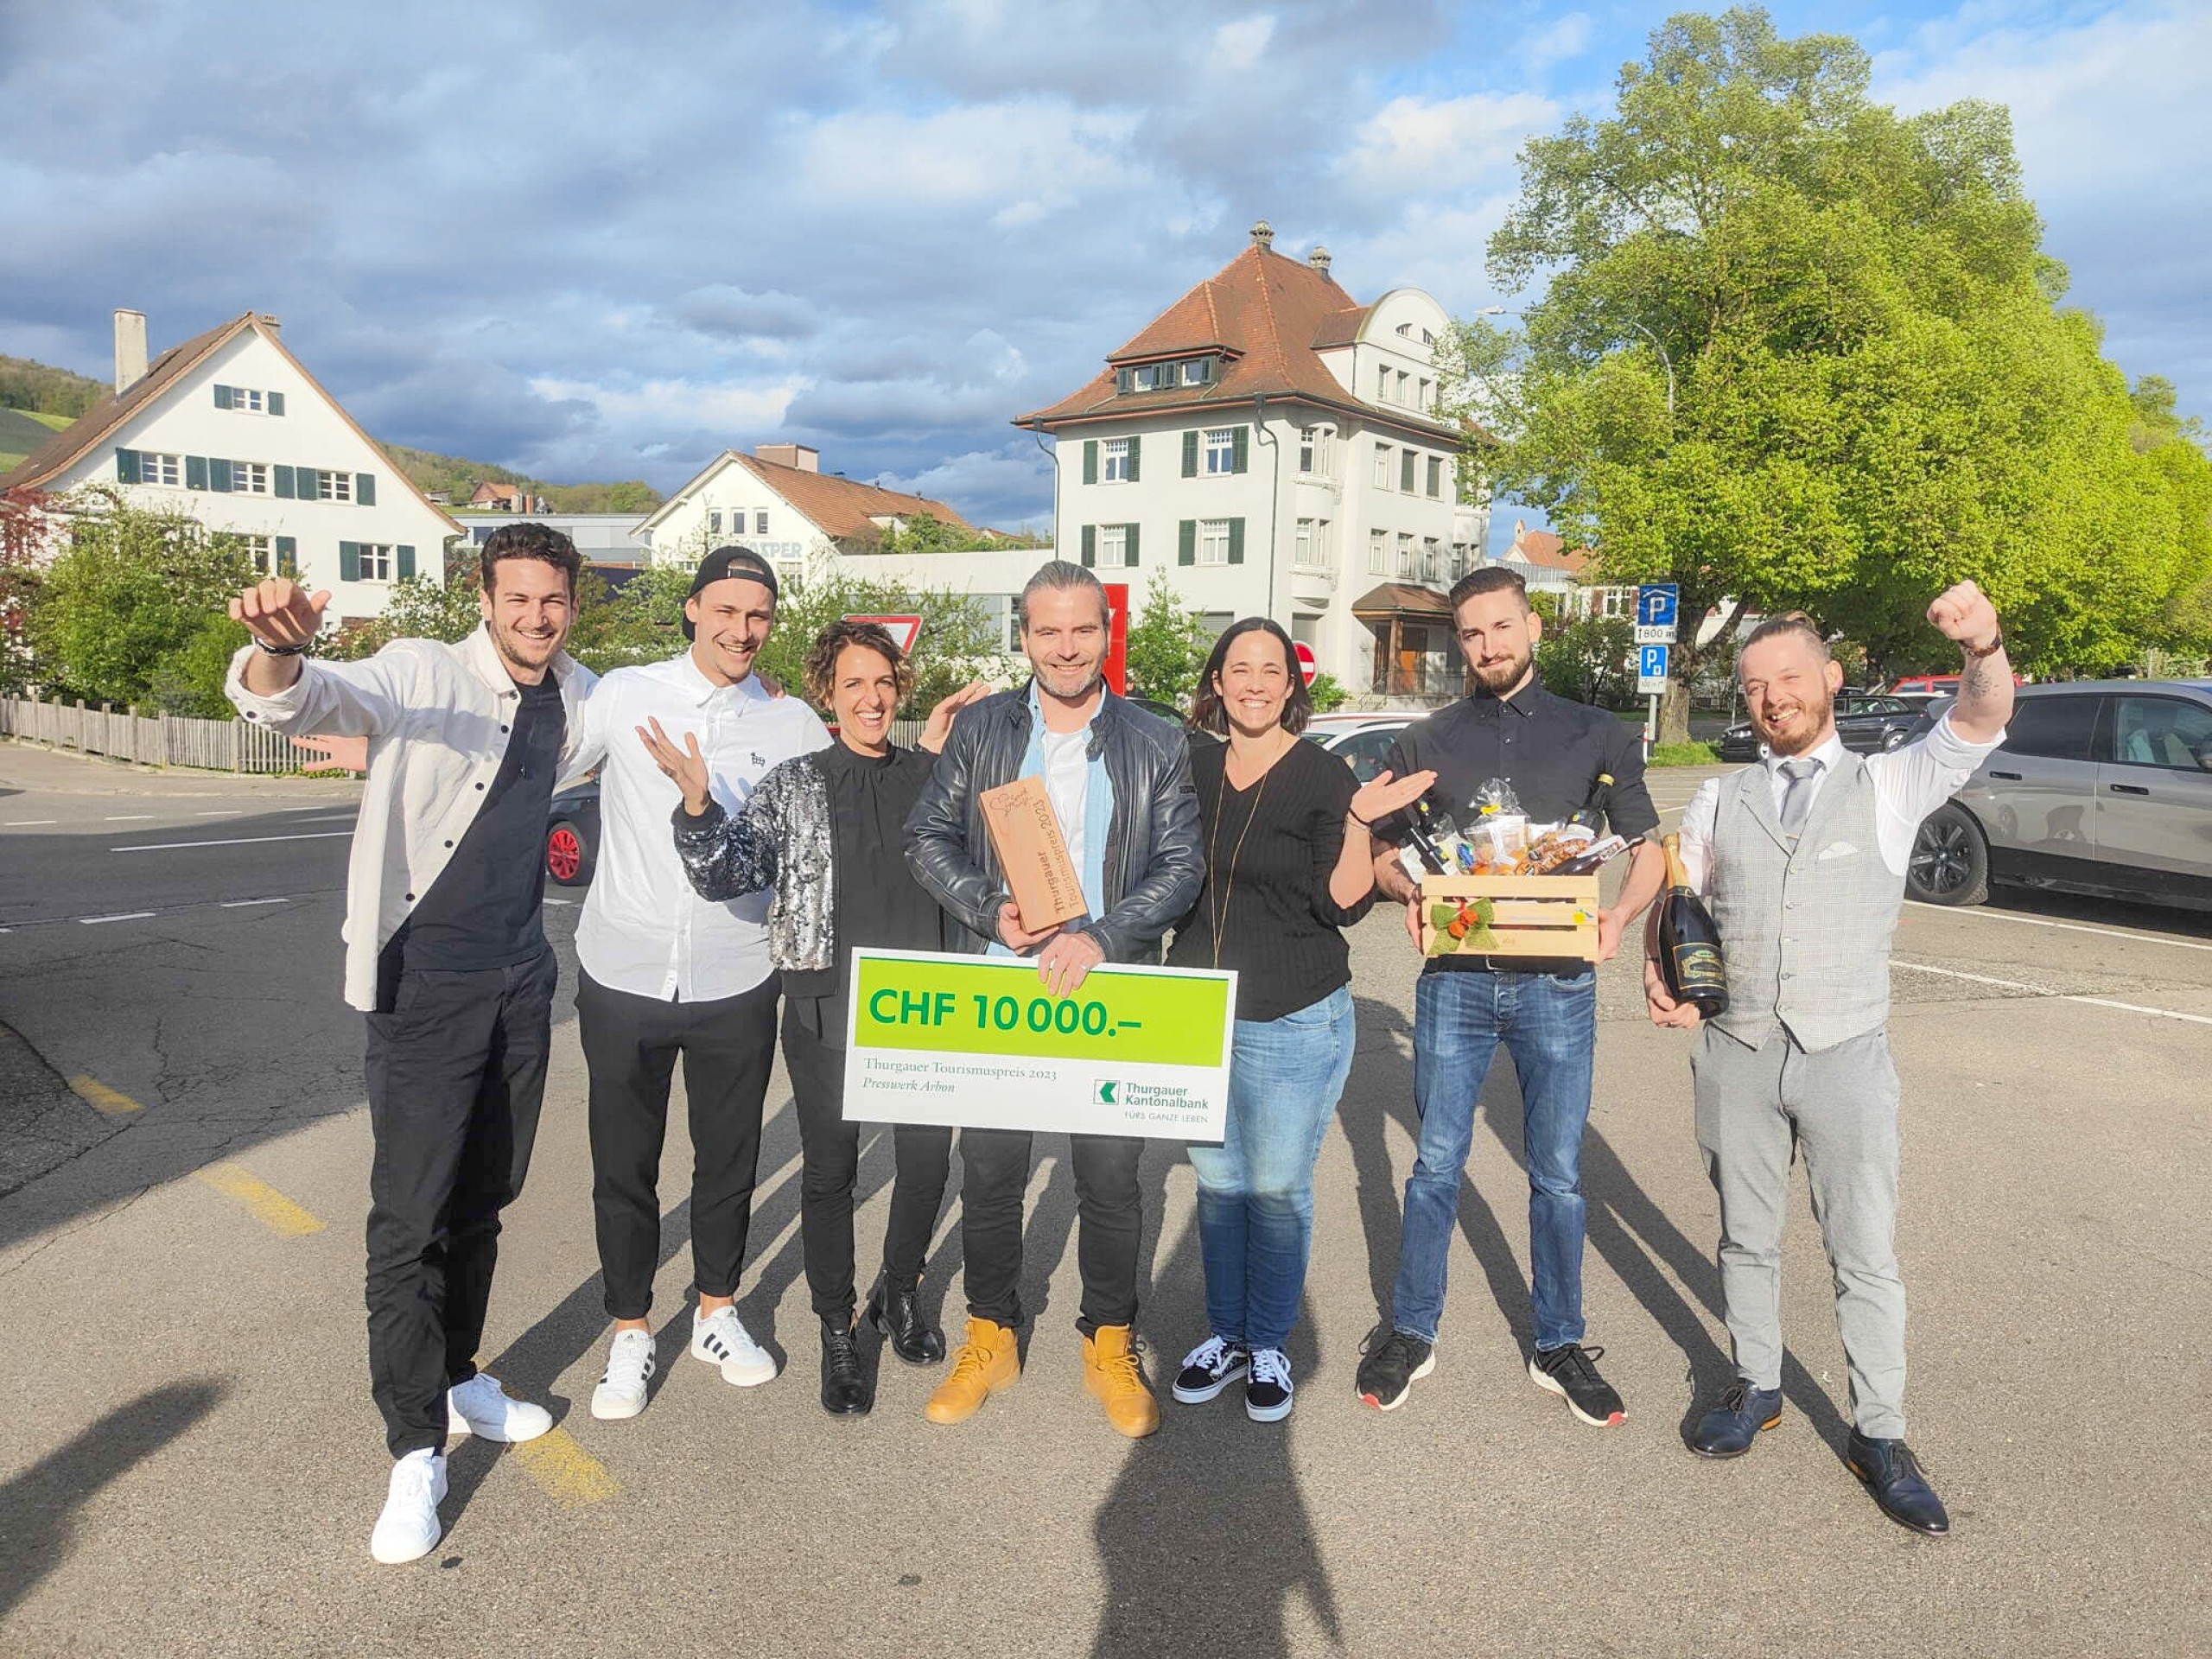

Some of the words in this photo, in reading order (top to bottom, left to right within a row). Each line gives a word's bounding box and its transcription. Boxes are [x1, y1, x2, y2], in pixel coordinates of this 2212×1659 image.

[1649, 596, 1666, 622] P
[1643, 629, 1663, 638] 800
[1646, 649, 1657, 669] P
[1033, 798, 1052, 830] 2023
[1037, 851, 1065, 915] Thurgauer
[869, 988, 956, 1027] CHF
[864, 1057, 929, 1073] Thurgauer
[932, 1061, 1026, 1080] Tourismuspreis
[1029, 1070, 1058, 1082] 2023
[862, 1077, 918, 1091] Presswerk
[919, 1079, 955, 1093] Arbon
[1125, 1082, 1188, 1097] Thurgauer
[1125, 1095, 1209, 1109] Kantonalbank
[1124, 1109, 1146, 1120] FÜRS
[1148, 1112, 1179, 1122] GANZE
[1182, 1114, 1208, 1123] LEBEN
